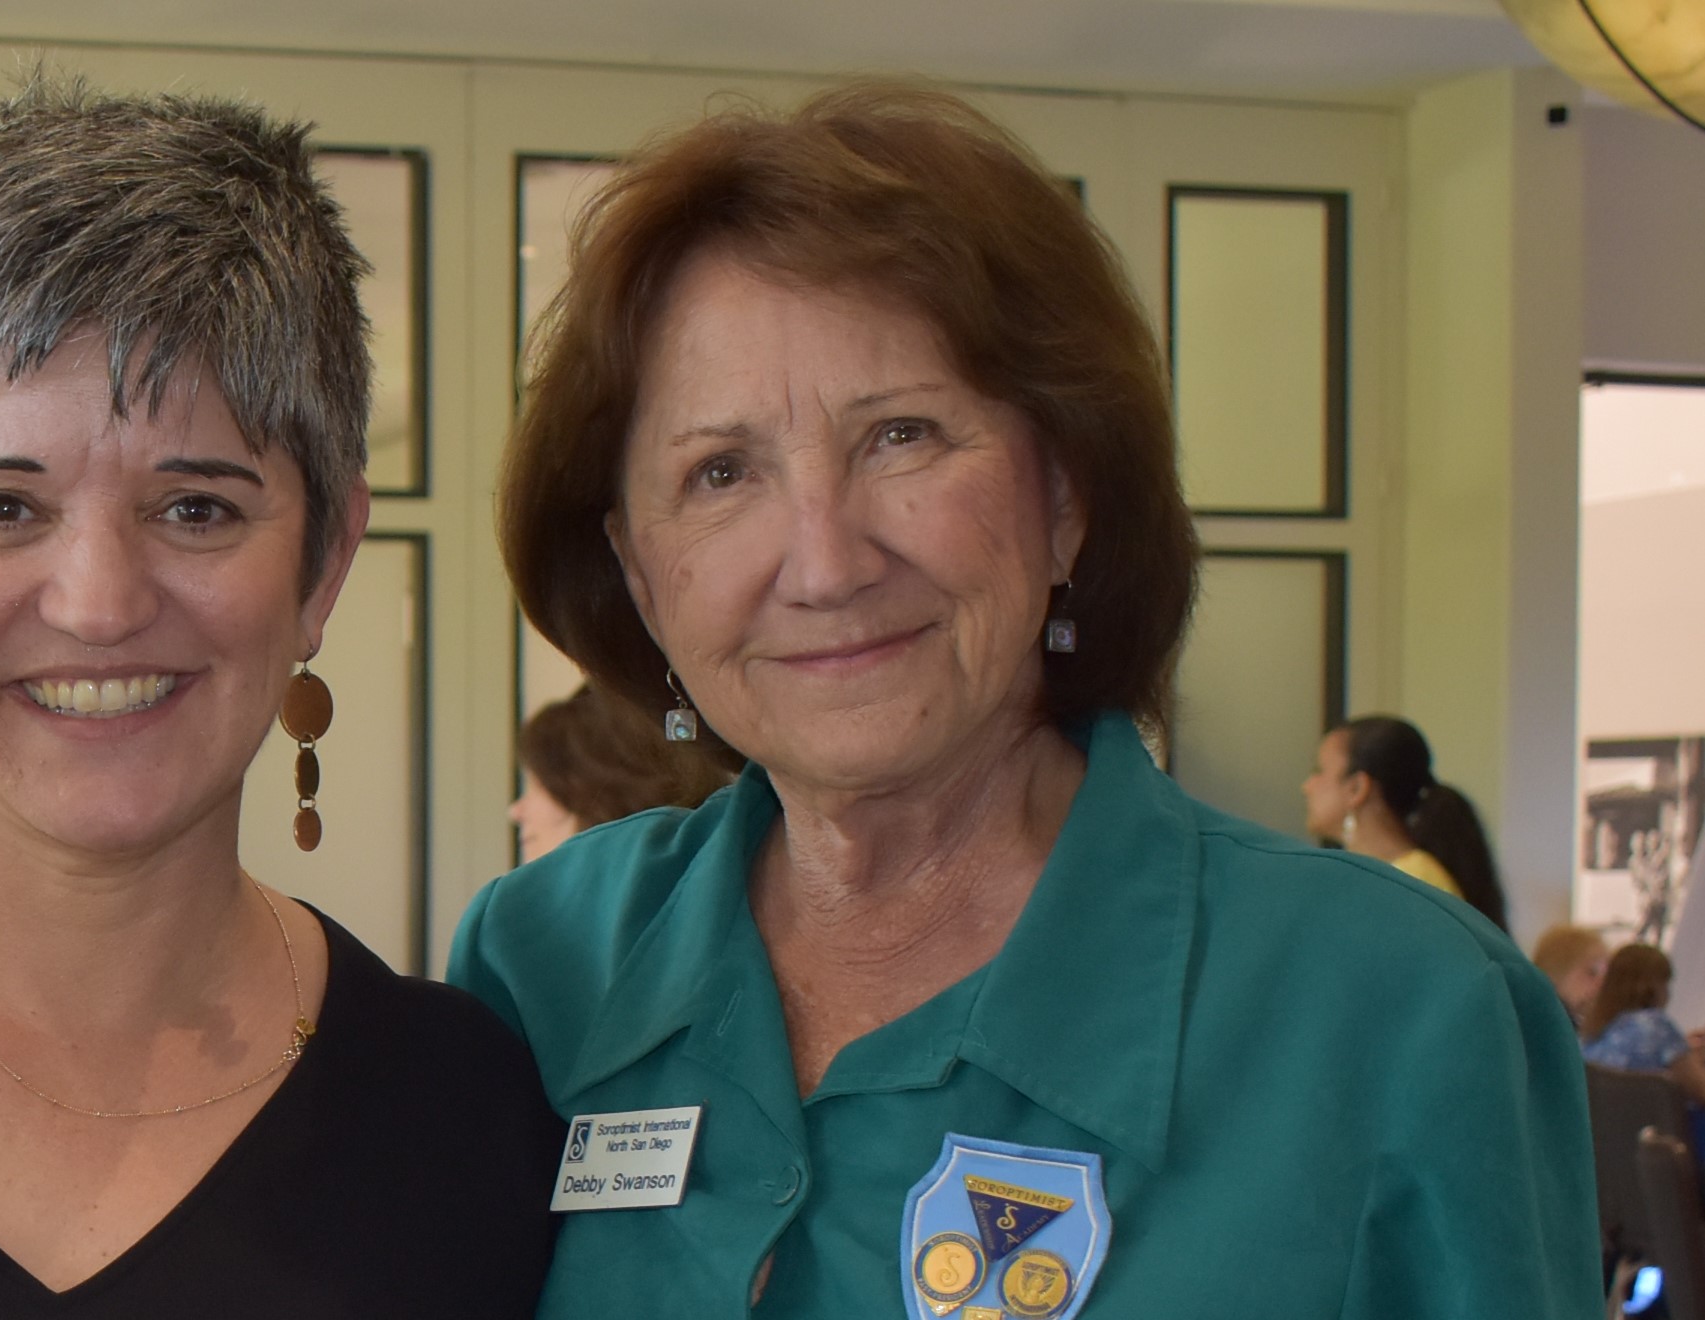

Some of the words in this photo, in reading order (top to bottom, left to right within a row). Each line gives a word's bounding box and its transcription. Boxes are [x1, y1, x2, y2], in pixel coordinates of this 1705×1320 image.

[597, 1121, 640, 1137] Soroptimist
[643, 1117, 692, 1133] International
[606, 1140, 629, 1152] North
[630, 1138, 647, 1151] San
[649, 1137, 673, 1151] Diego
[562, 1174, 607, 1195] Debby
[612, 1172, 676, 1192] Swanson
[967, 1178, 1066, 1210] SOROPTIMIST
